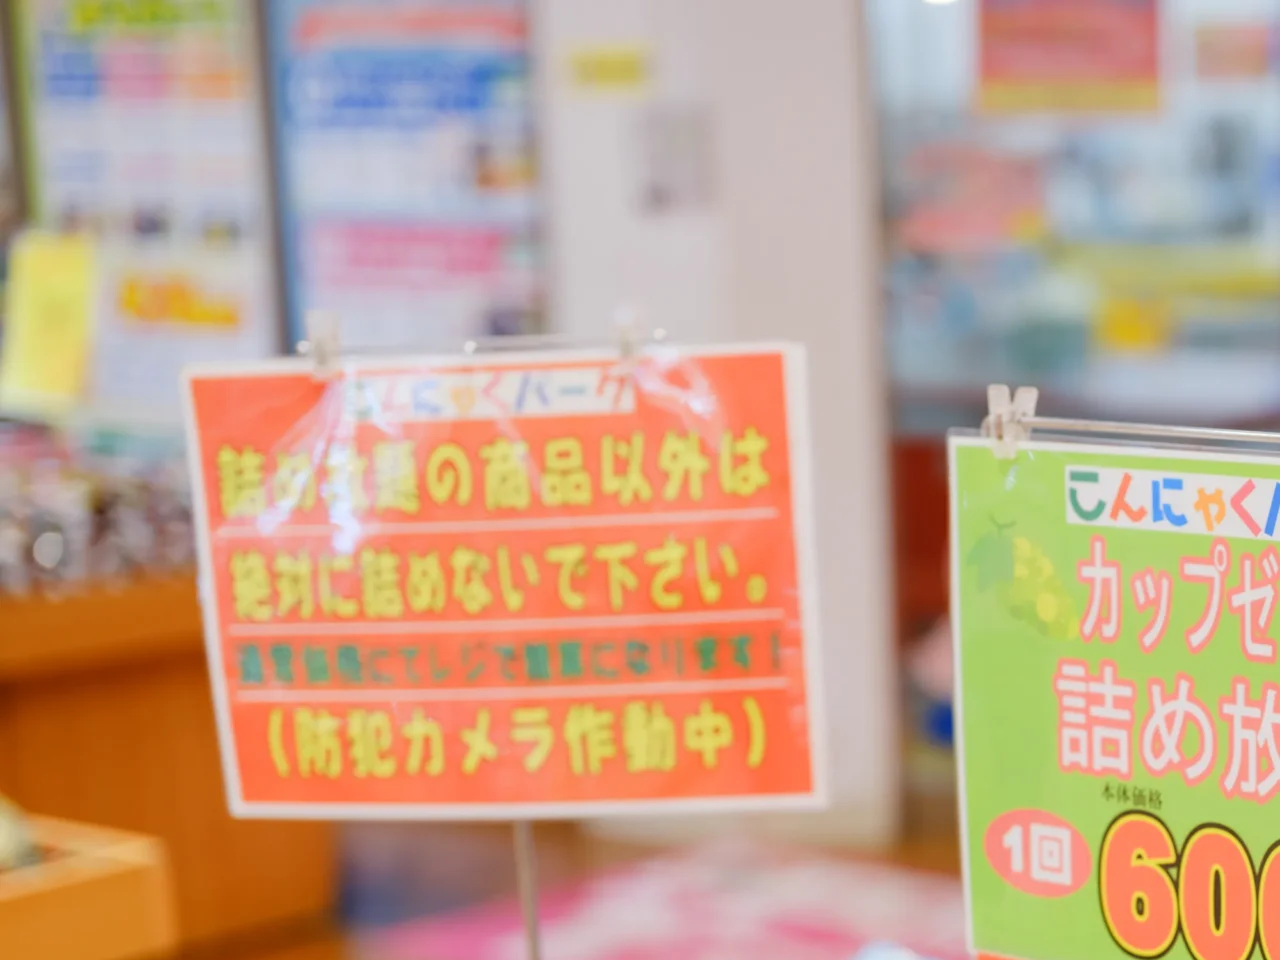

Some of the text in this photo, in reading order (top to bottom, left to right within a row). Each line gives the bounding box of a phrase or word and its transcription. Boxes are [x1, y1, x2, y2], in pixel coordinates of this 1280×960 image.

[217, 428, 769, 517] 詰め題の商品以外は
[1101, 782, 1163, 809] 本体価格
[1002, 824, 1071, 886] 1回
